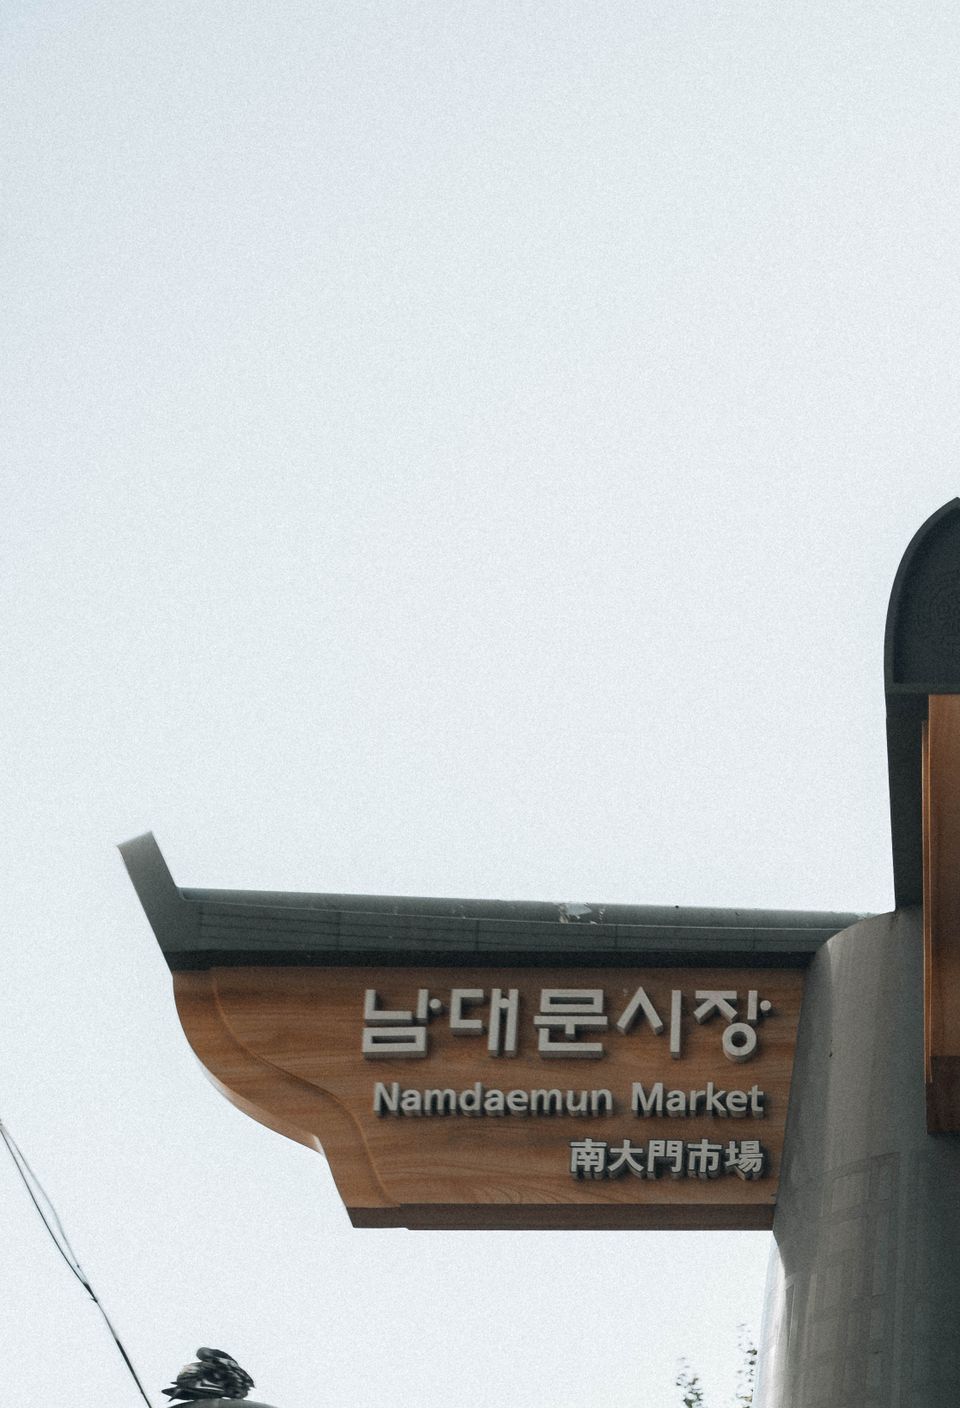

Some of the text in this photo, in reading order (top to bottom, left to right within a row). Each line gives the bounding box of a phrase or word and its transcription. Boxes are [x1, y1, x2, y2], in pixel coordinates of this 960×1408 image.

[361, 986, 772, 1062] 남대문시장
[373, 1082, 765, 1117] Namdaemun Market
[569, 1138, 765, 1179] 南大門市場
